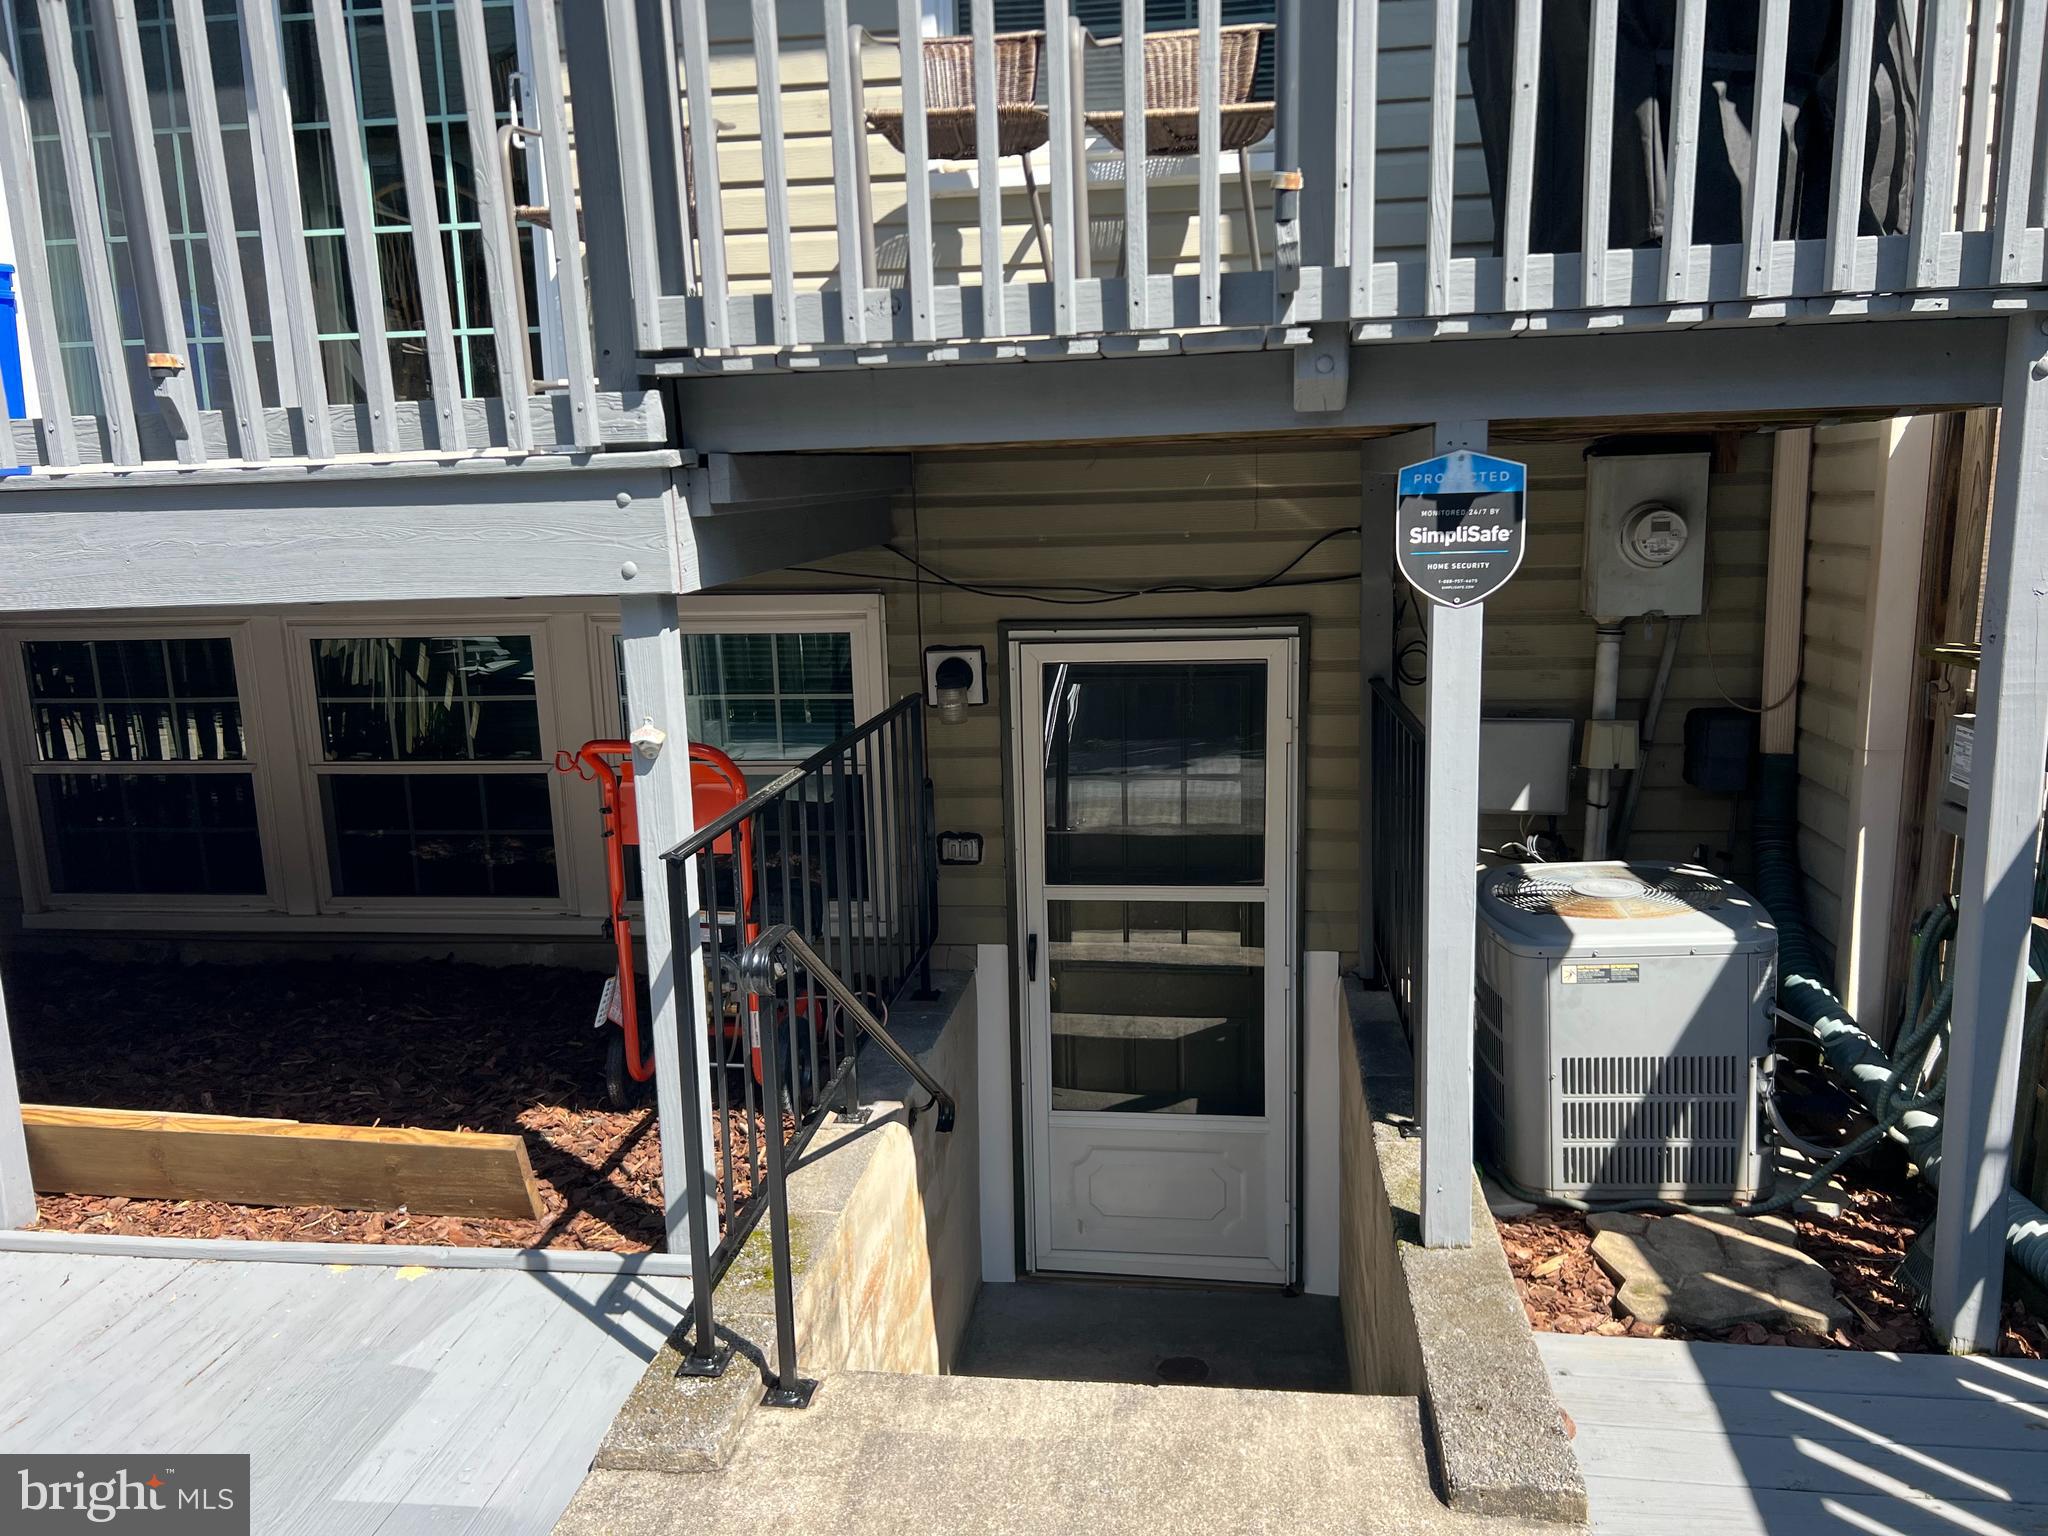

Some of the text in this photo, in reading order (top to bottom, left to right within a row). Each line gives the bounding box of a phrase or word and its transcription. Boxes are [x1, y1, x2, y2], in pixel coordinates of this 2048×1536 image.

[1414, 471, 1510, 485] PROCTED
[1421, 509, 1466, 517] MONITORED
[1468, 508, 1487, 516] 24/7
[1409, 525, 1512, 546] SimpliSafe
